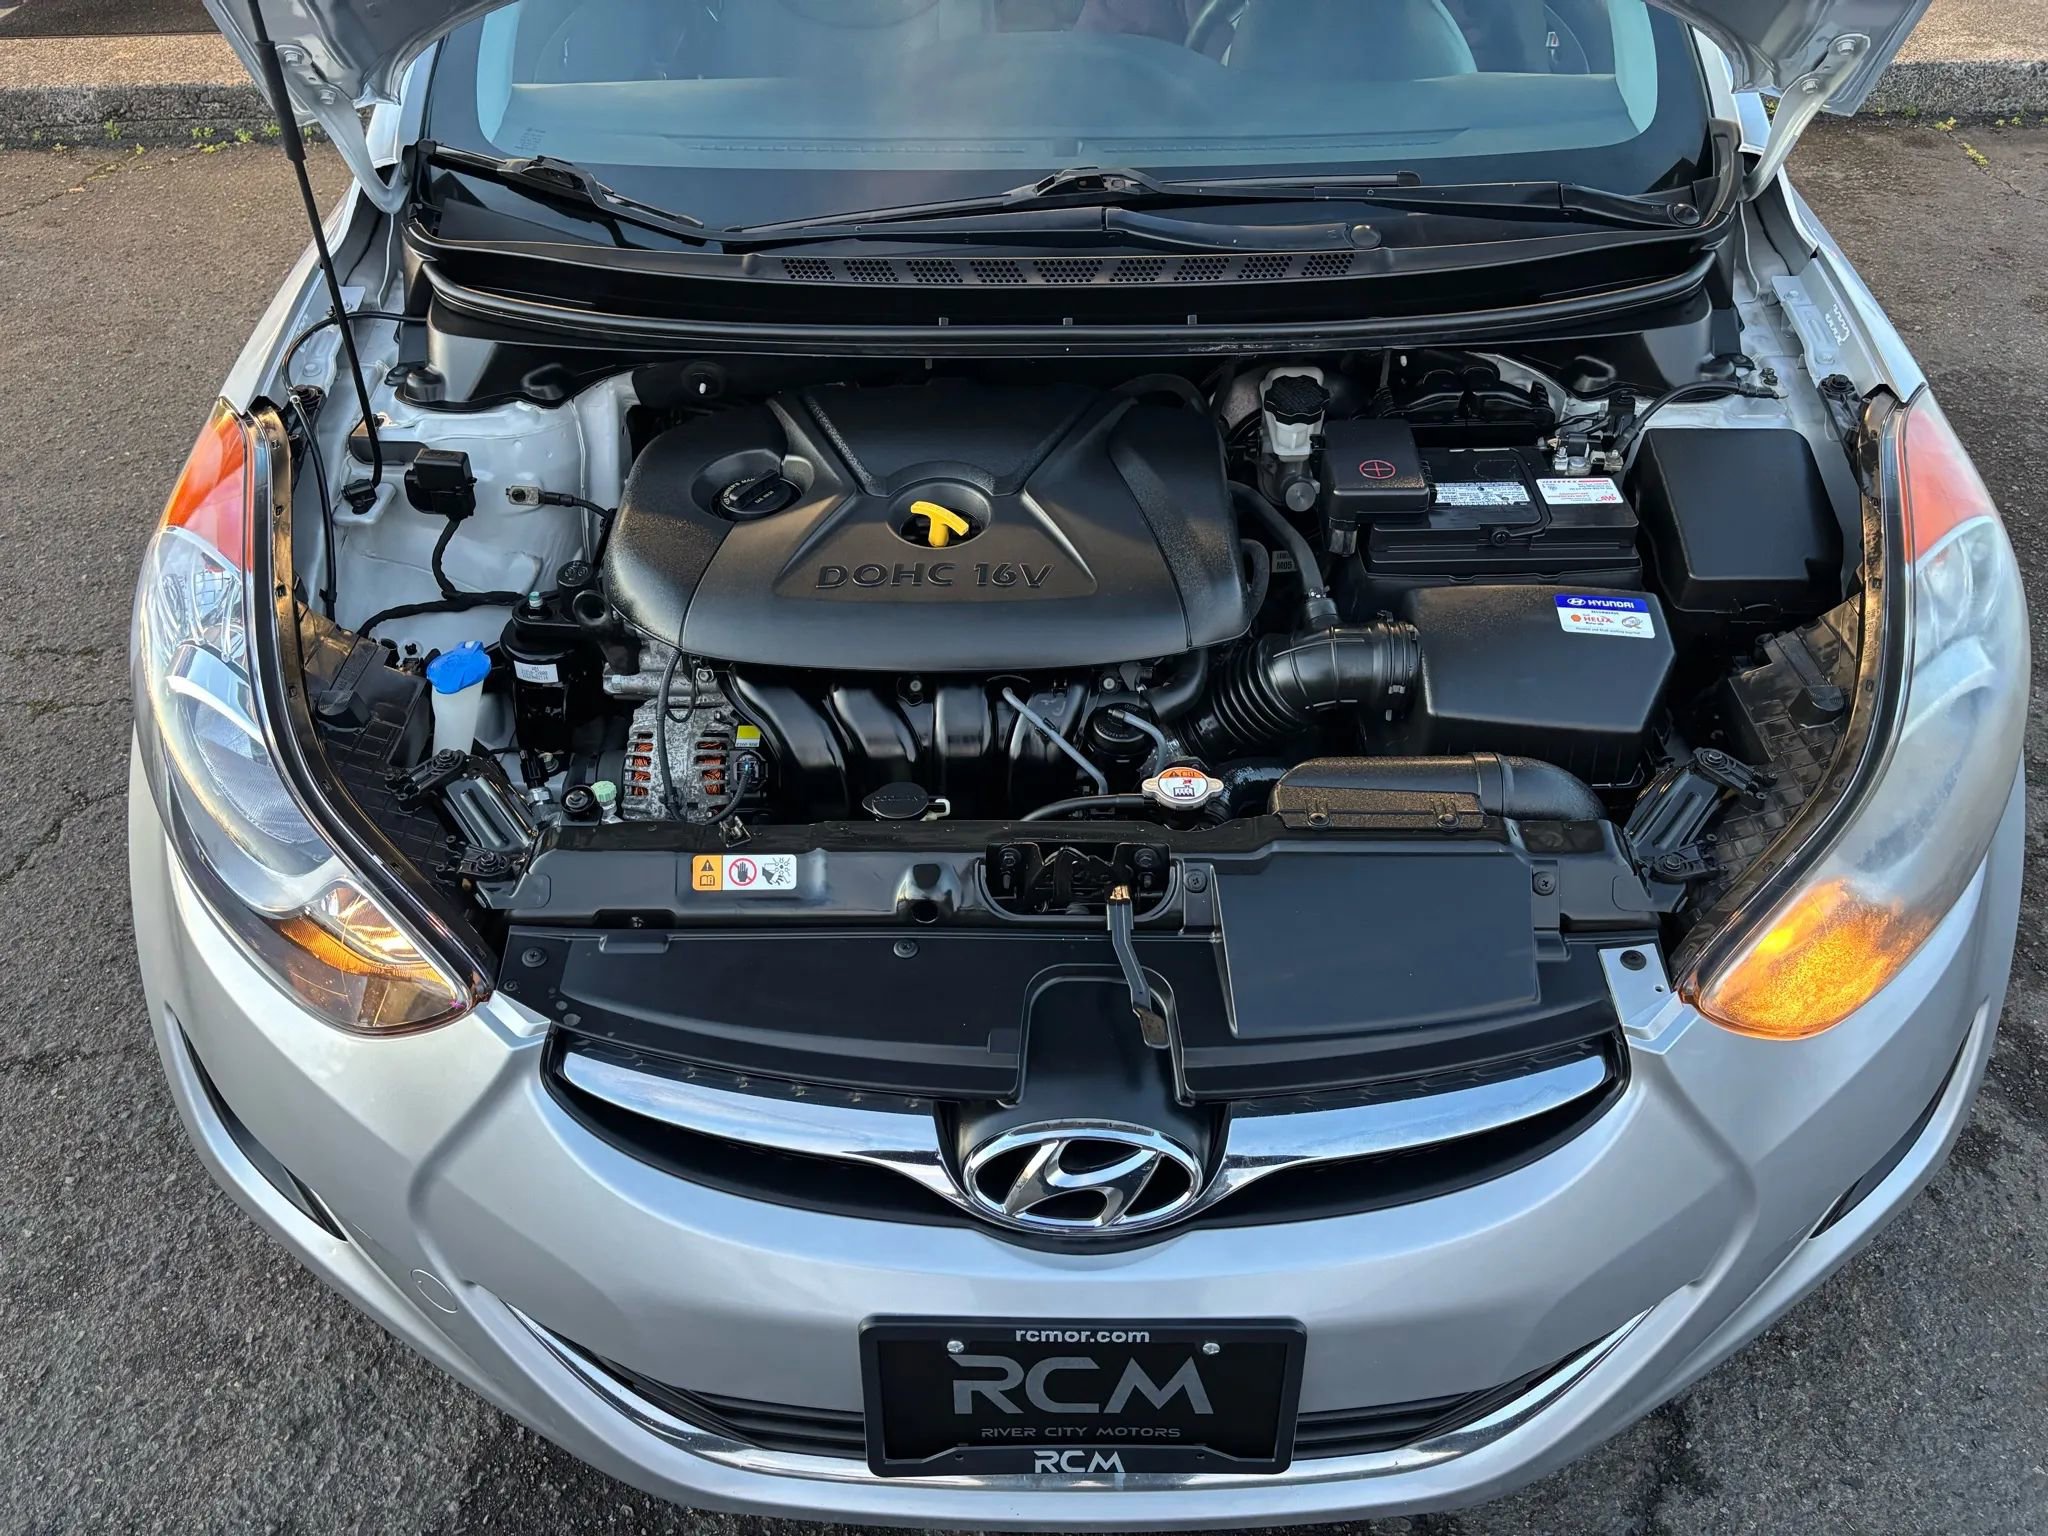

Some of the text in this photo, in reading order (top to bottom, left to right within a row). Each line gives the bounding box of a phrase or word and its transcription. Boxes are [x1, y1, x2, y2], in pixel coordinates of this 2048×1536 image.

[816, 562, 1053, 588] DOHC 16V
[1588, 599, 1635, 609] HYUNDAI
[1015, 1329, 1150, 1343] rcmor.com
[948, 1354, 1214, 1415] RCM
[981, 1426, 1181, 1438] RIVER CITY MOTORS
[1033, 1450, 1125, 1474] RCM
